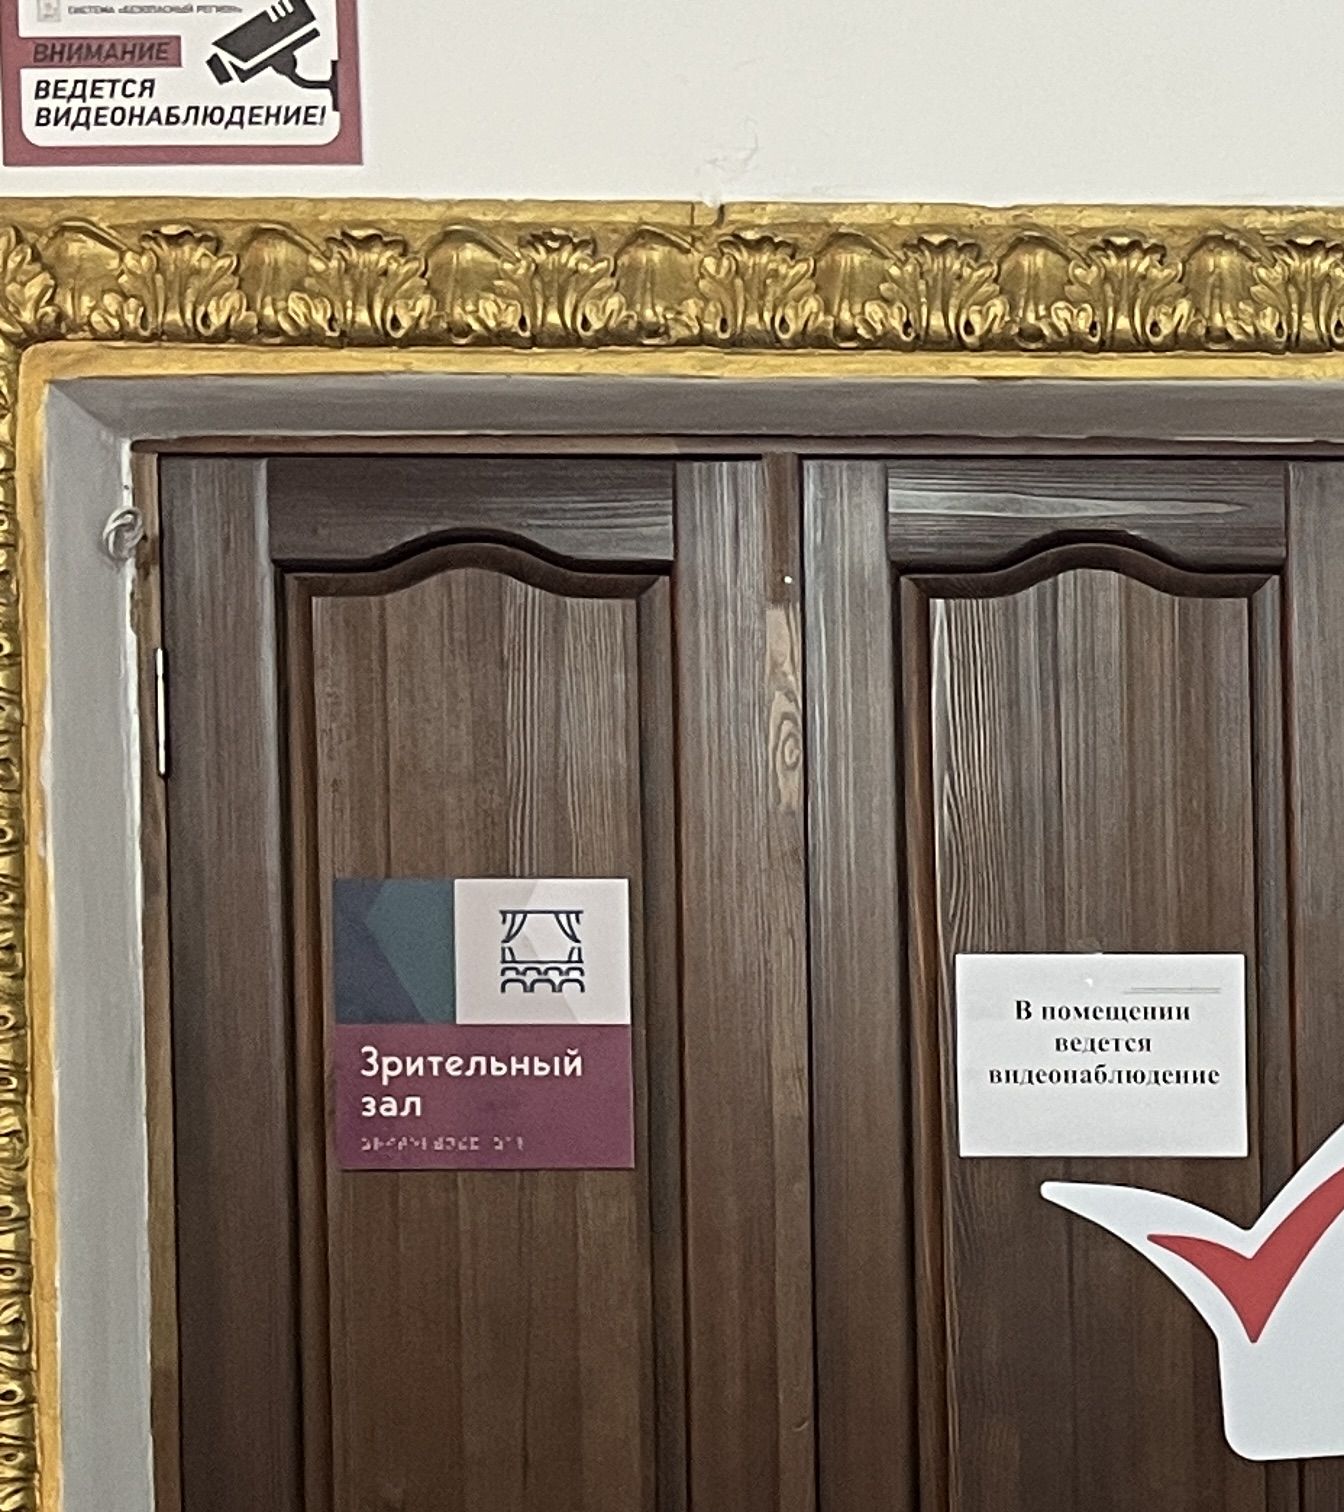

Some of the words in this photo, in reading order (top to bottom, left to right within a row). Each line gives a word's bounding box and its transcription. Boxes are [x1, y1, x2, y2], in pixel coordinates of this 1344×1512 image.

[32, 42, 171, 64] ВНИМАНИЕ
[34, 78, 156, 102] ВЕДЕТСЯ
[34, 105, 327, 131] ВИДЕОНАБЛЮДЕНИЕ!
[1015, 999, 1032, 1021] В
[1041, 1004, 1191, 1023] помещении
[1054, 1036, 1152, 1054] ведется
[360, 1045, 584, 1086] Зрительный
[988, 1063, 1221, 1086] видеонаблюдение
[360, 1095, 422, 1118] зал
